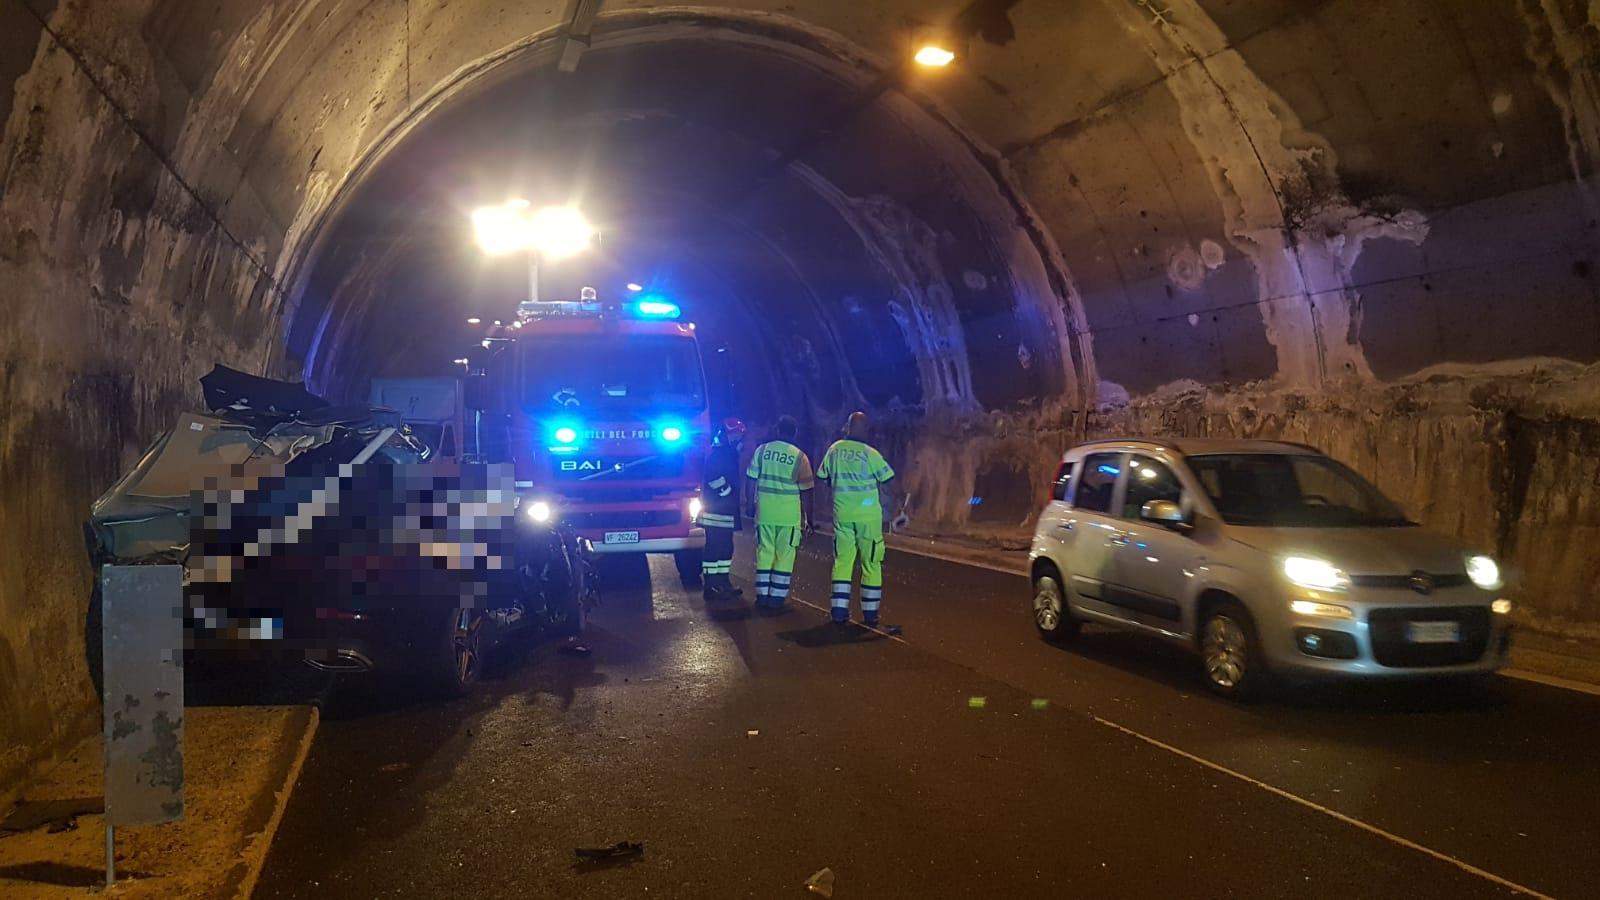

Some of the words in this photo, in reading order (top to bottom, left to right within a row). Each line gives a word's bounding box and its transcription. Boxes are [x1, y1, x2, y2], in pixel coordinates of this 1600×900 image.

[609, 430, 626, 439] DEL
[632, 430, 656, 439] FUOC
[763, 449, 795, 466] anas
[561, 460, 600, 471] BAI
